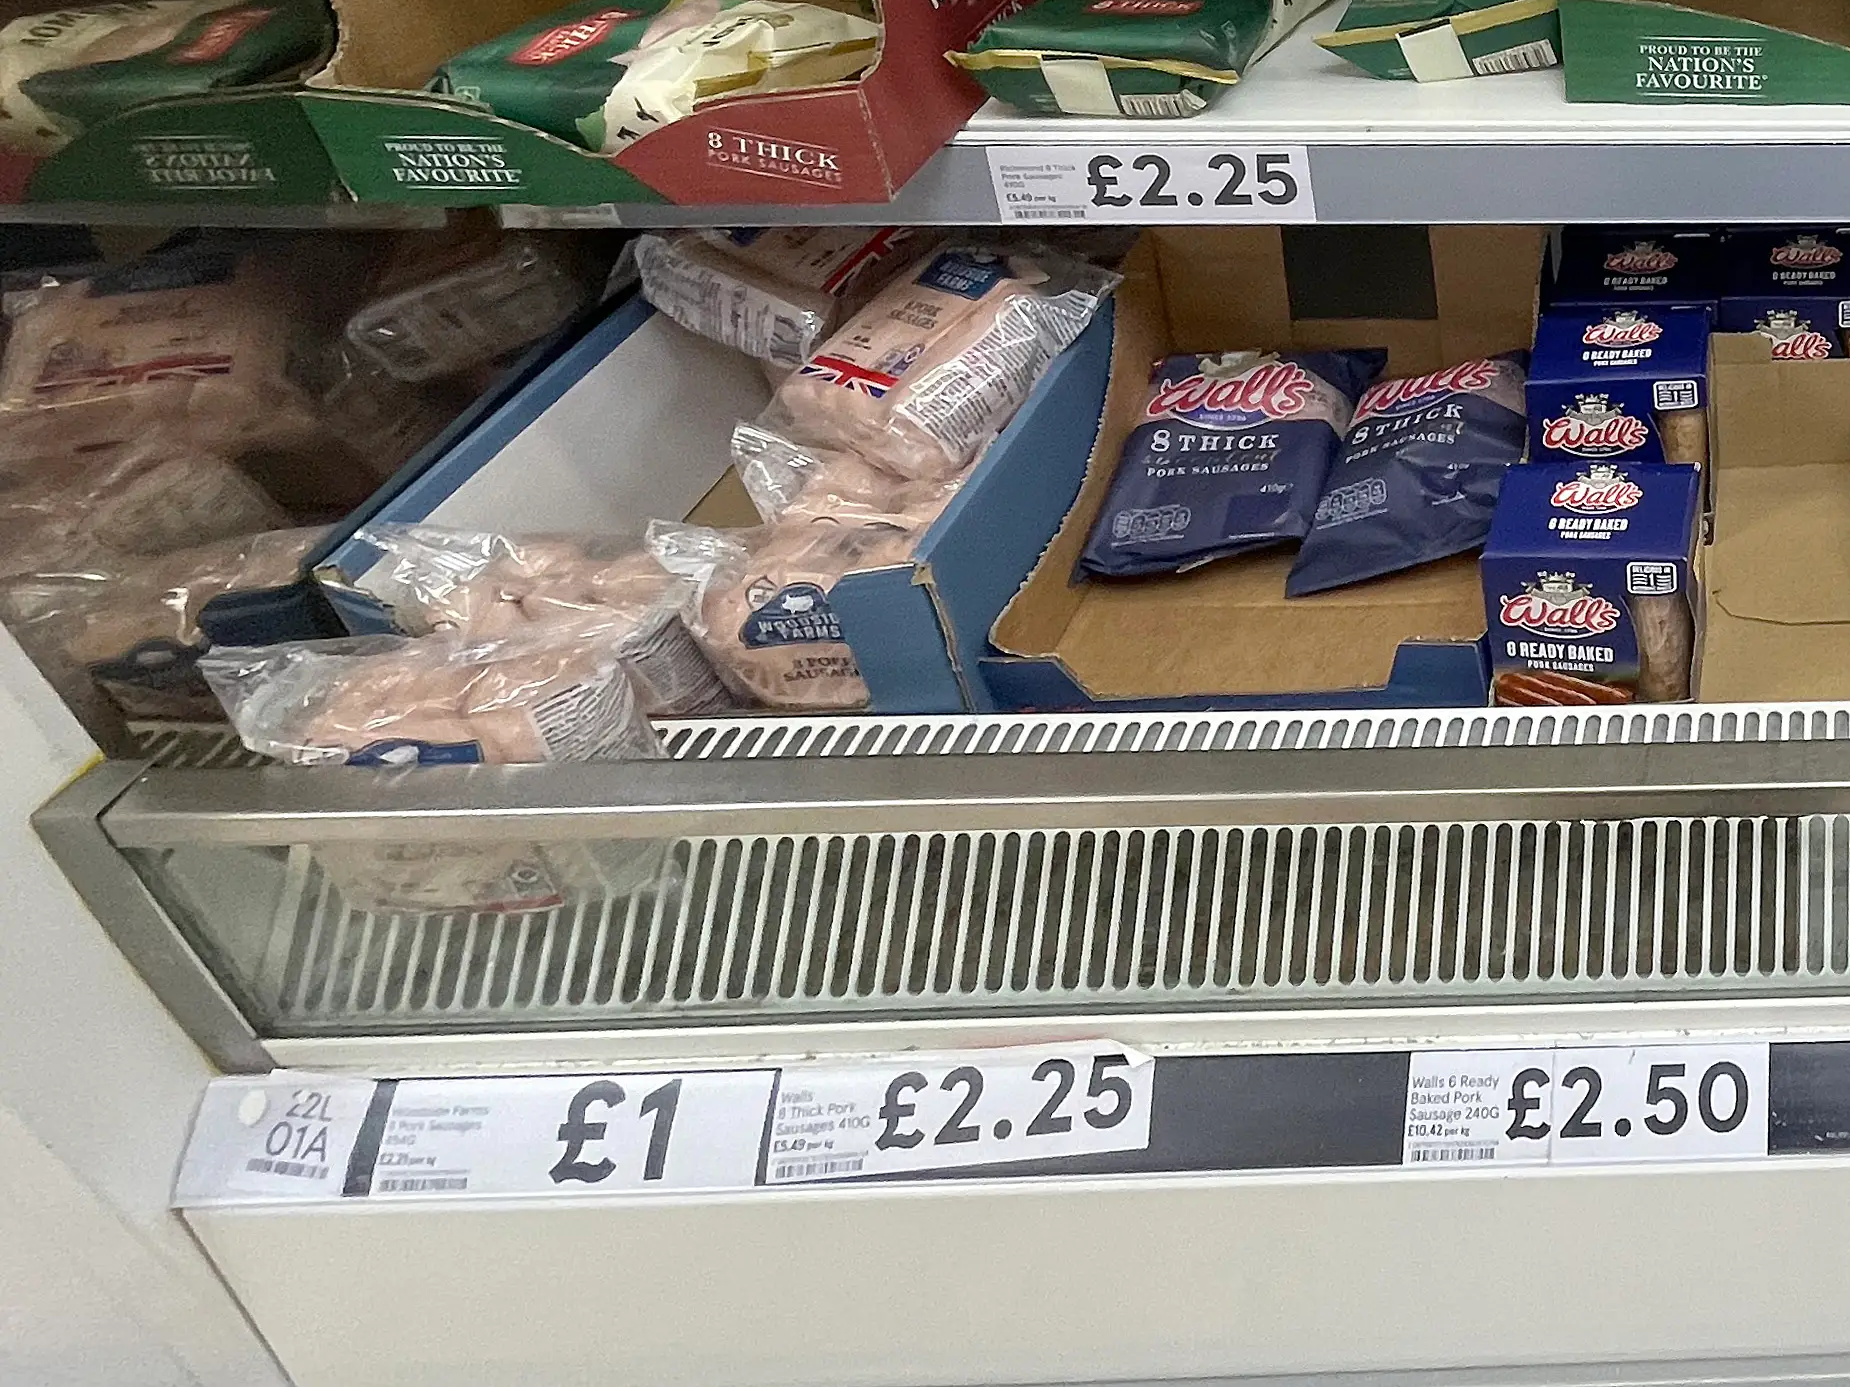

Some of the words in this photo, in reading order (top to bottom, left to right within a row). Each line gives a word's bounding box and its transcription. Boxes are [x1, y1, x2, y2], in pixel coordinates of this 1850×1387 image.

[1640, 45, 1687, 55] PROUD
[1691, 46, 1707, 55] TO
[1711, 46, 1730, 55] BE
[1735, 46, 1763, 56] THE
[1648, 58, 1754, 73] NATION'S
[398, 153, 505, 169] NATION'S
[708, 132, 723, 150] 8
[728, 136, 839, 171] THICK
[1087, 154, 1298, 207] £2.25
[1593, 350, 1621, 361] READY
[1623, 348, 1651, 360] BAKED
[1147, 362, 1314, 417] Wall's
[1352, 427, 1367, 444] 8
[1376, 404, 1462, 436] THICK
[1151, 430, 1170, 451] 8
[1178, 433, 1279, 451] THICK
[1147, 467, 1186, 477] PORK
[1192, 462, 1268, 475] SAUSAGES
[1412, 1076, 1445, 1088] Walls
[1460, 1075, 1499, 1090] Ready
[875, 1054, 1132, 1151] £2.25
[1411, 1091, 1450, 1104] Baked
[1454, 1091, 1482, 1103] Pork
[1506, 1061, 1748, 1140] £2.50
[1409, 1108, 1462, 1121] Sausage
[1465, 1106, 1499, 1119] 240G
[548, 1079, 682, 1185] £1
[776, 1120, 835, 1134] Sausages
[839, 1116, 869, 1130] 410G
[265, 1122, 329, 1162] 01A
